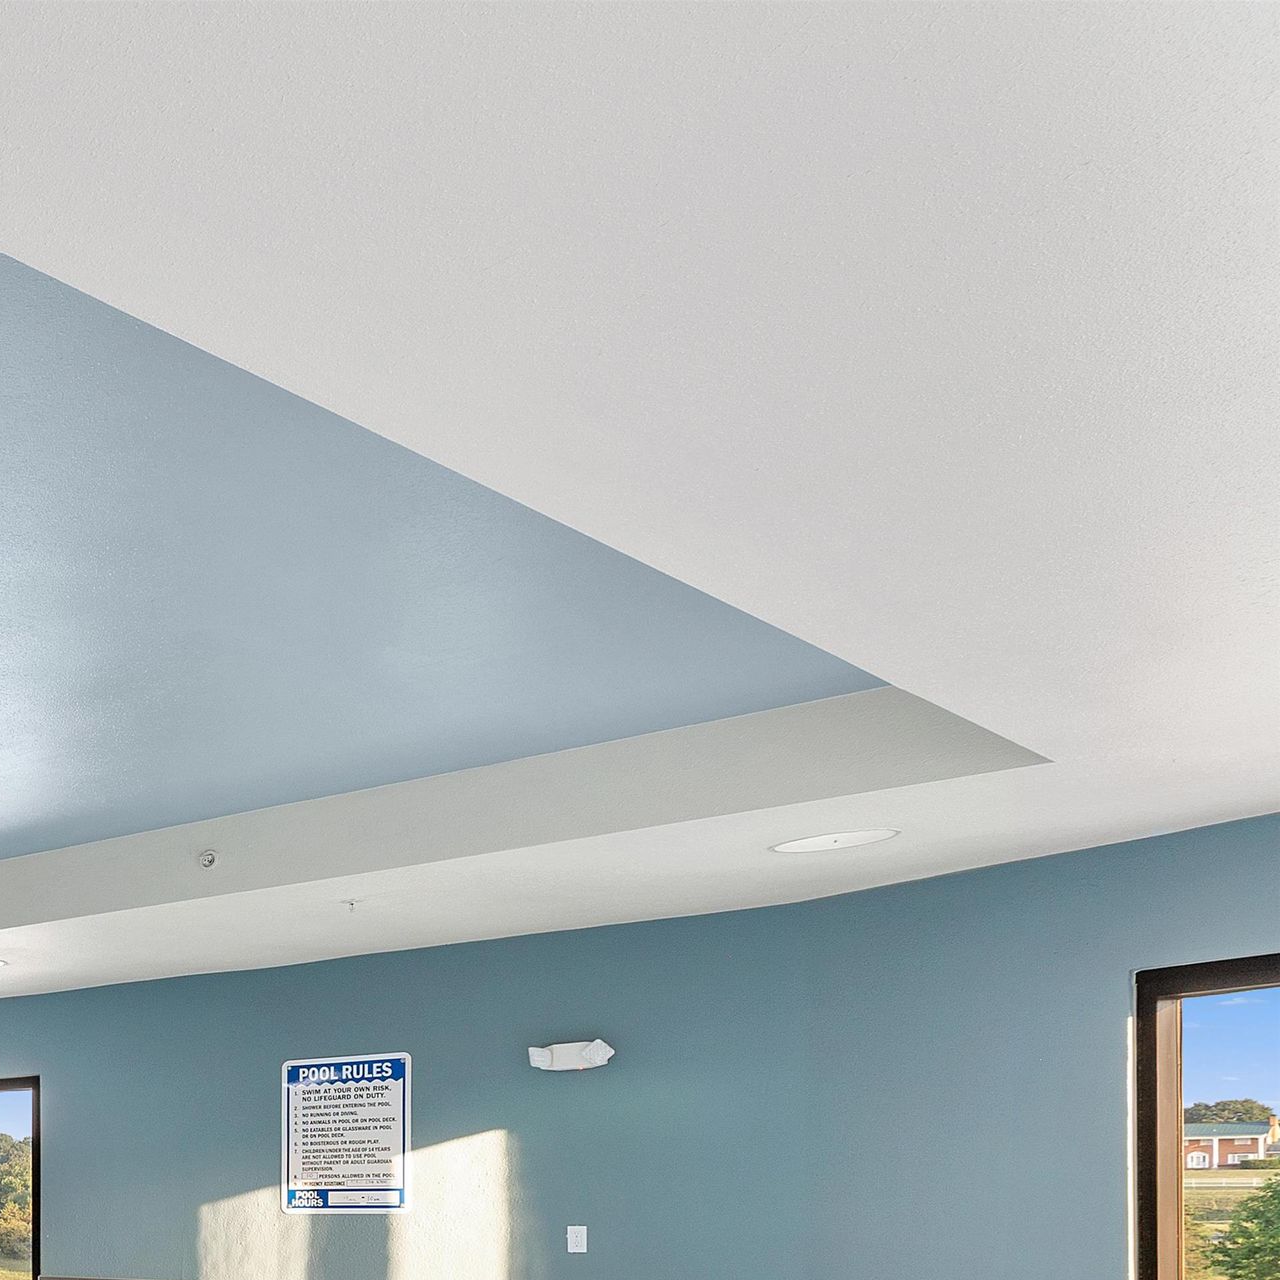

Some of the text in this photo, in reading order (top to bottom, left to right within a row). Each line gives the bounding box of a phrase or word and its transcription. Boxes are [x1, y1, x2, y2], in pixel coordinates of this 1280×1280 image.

[299, 1063, 392, 1082] POOL RULES
[295, 1191, 320, 1199] POOL
[291, 1199, 324, 1207] HOURS
